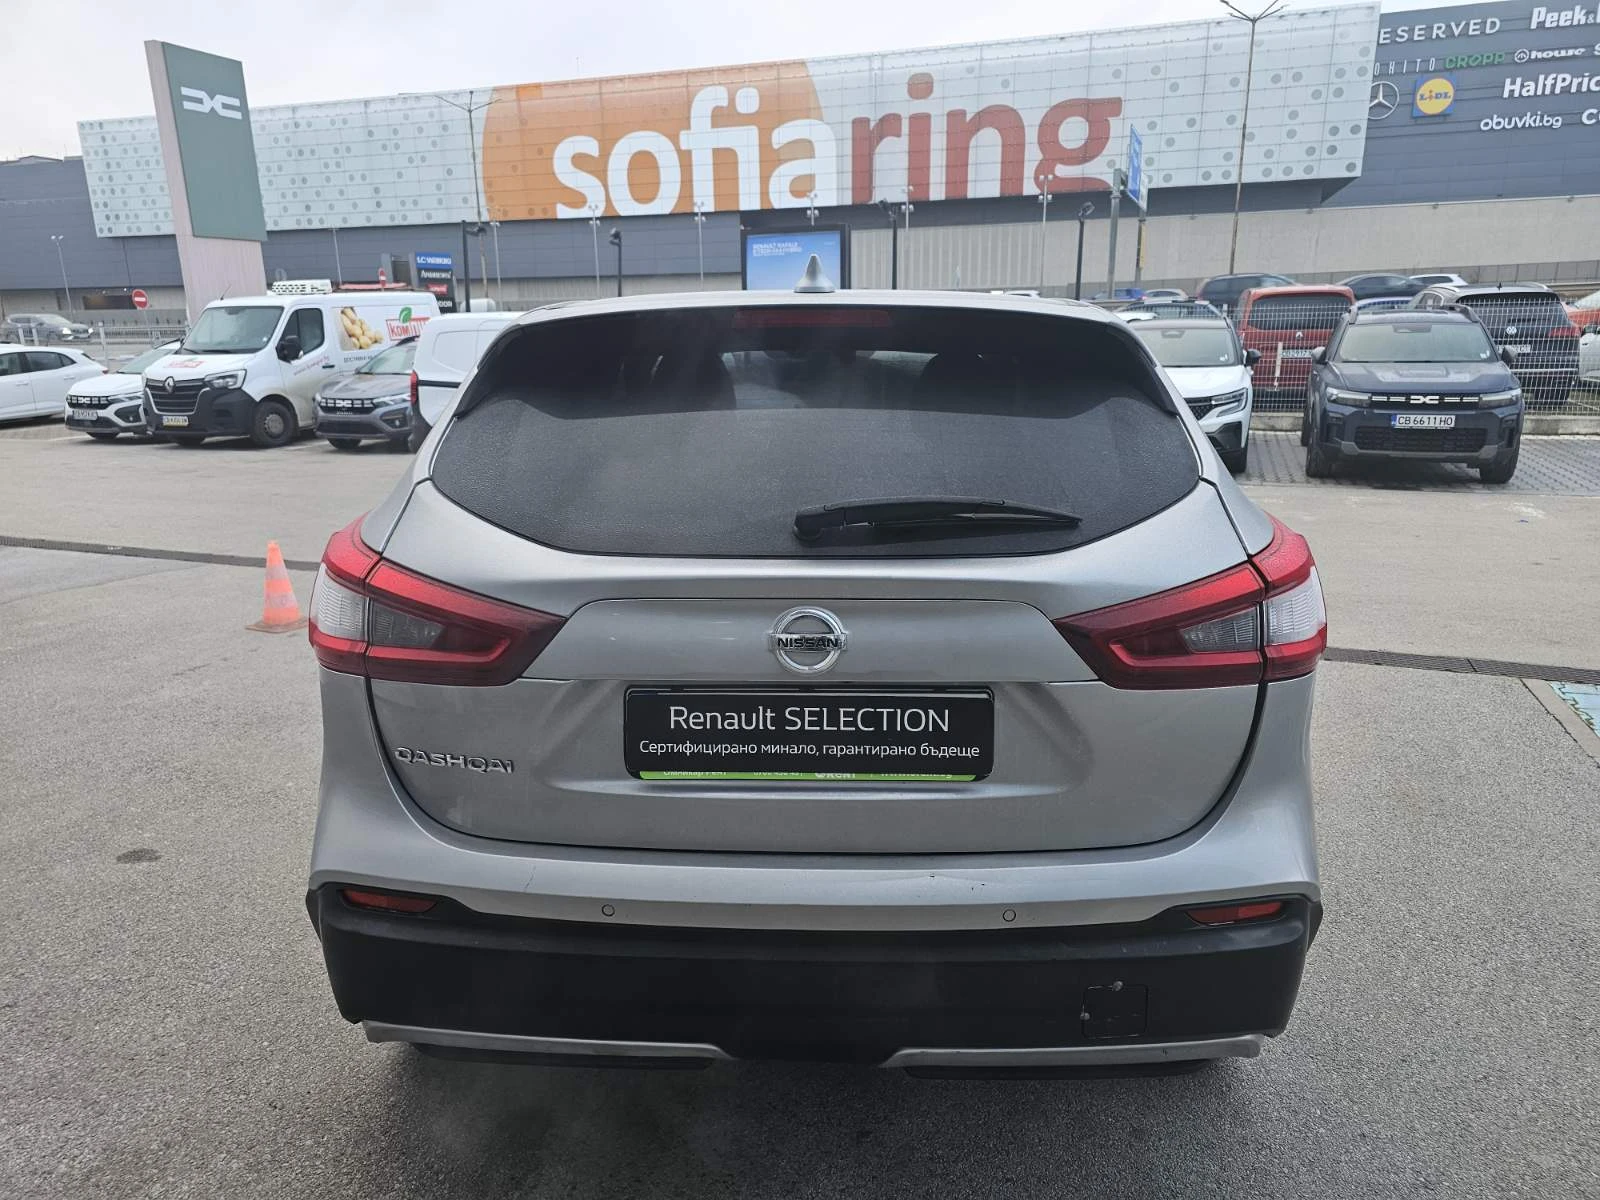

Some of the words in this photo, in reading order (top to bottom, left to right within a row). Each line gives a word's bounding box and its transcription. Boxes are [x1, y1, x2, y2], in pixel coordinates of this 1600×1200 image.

[1379, 18, 1500, 44] ESERVED
[1445, 52, 1504, 69] CROPP
[1480, 111, 1562, 130] obuvki.bg
[1413, 416, 1437, 425] 6611
[777, 637, 839, 648] NISSAN
[669, 705, 776, 730] Renault
[785, 707, 949, 732] SELECTION
[639, 740, 758, 756] Сертифицирано
[761, 743, 819, 756] минало,
[823, 744, 917, 758] гарантирано
[920, 743, 980, 758] бъдеще
